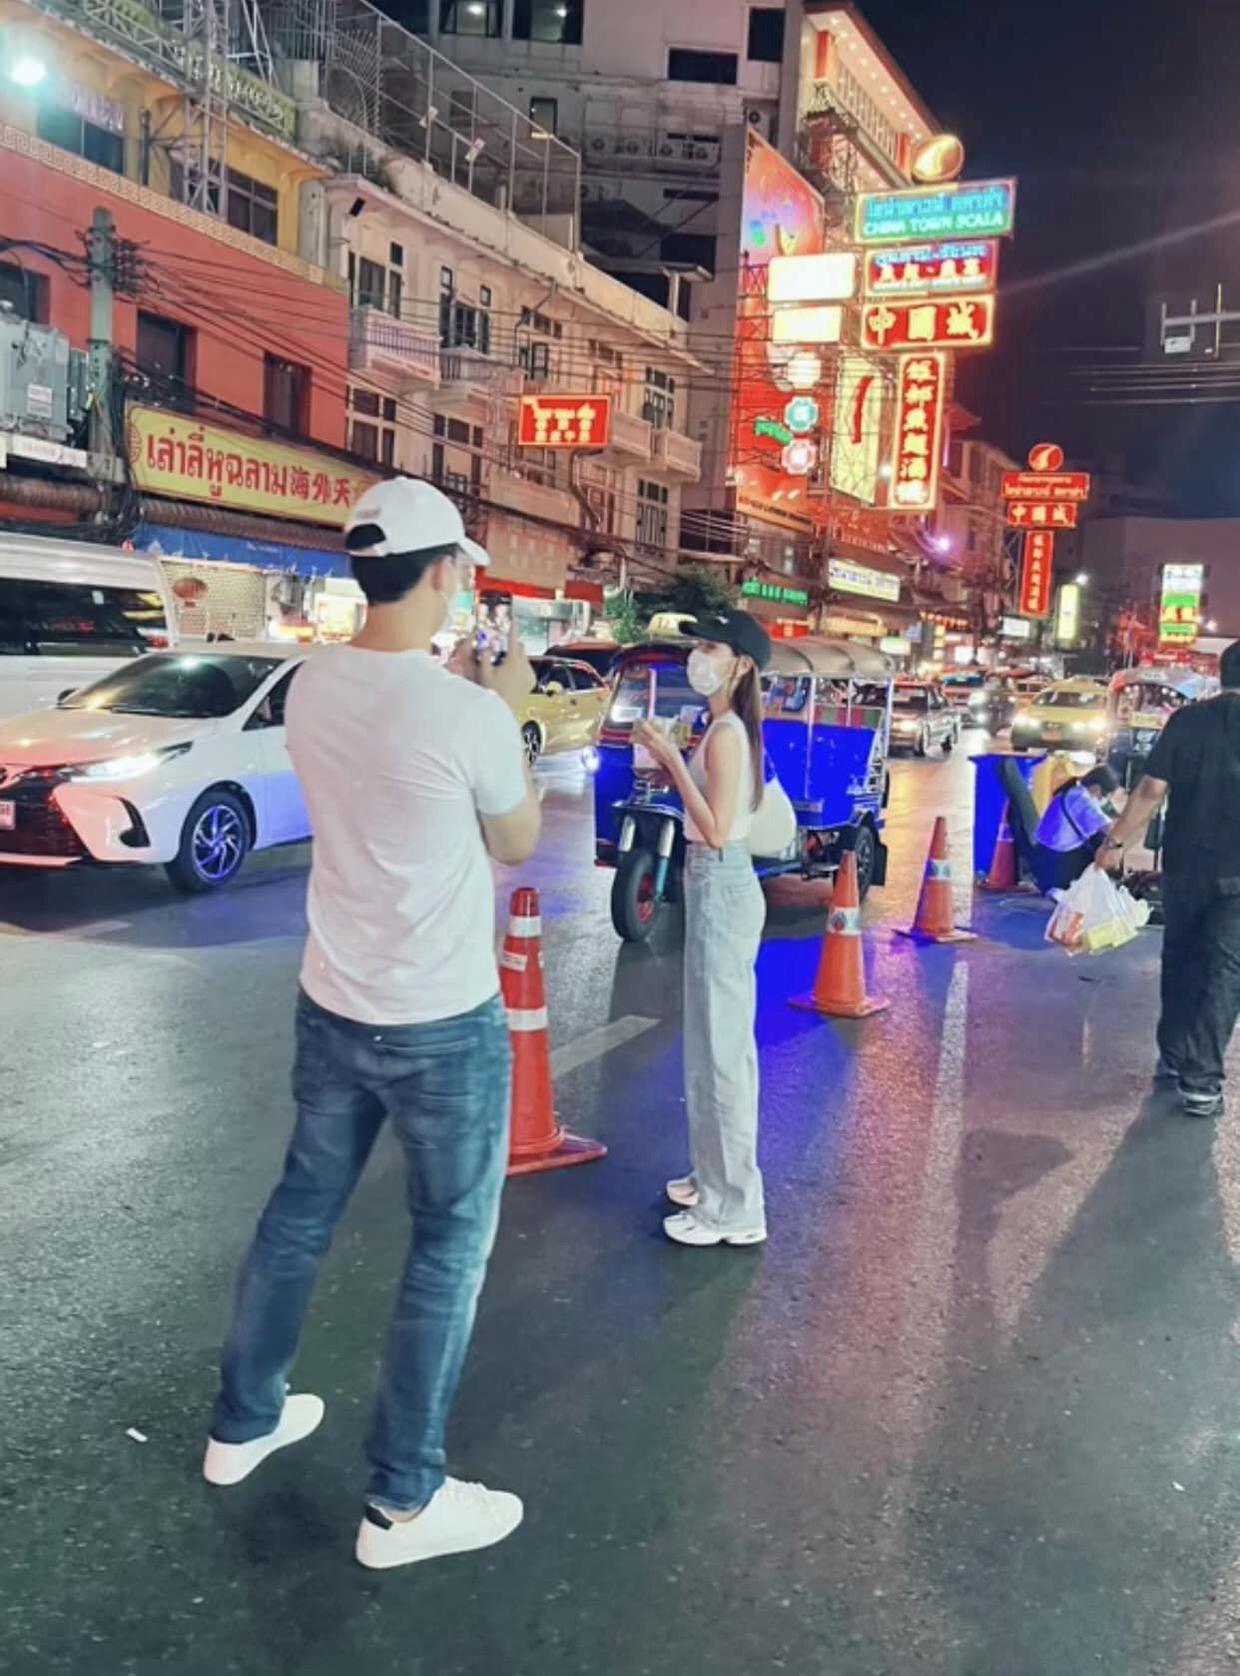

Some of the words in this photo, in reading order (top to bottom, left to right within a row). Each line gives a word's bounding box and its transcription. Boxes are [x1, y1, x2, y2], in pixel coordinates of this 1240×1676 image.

[909, 216, 953, 232] TOWN
[954, 210, 1005, 228] SCALA
[289, 464, 352, 508] 海外天
